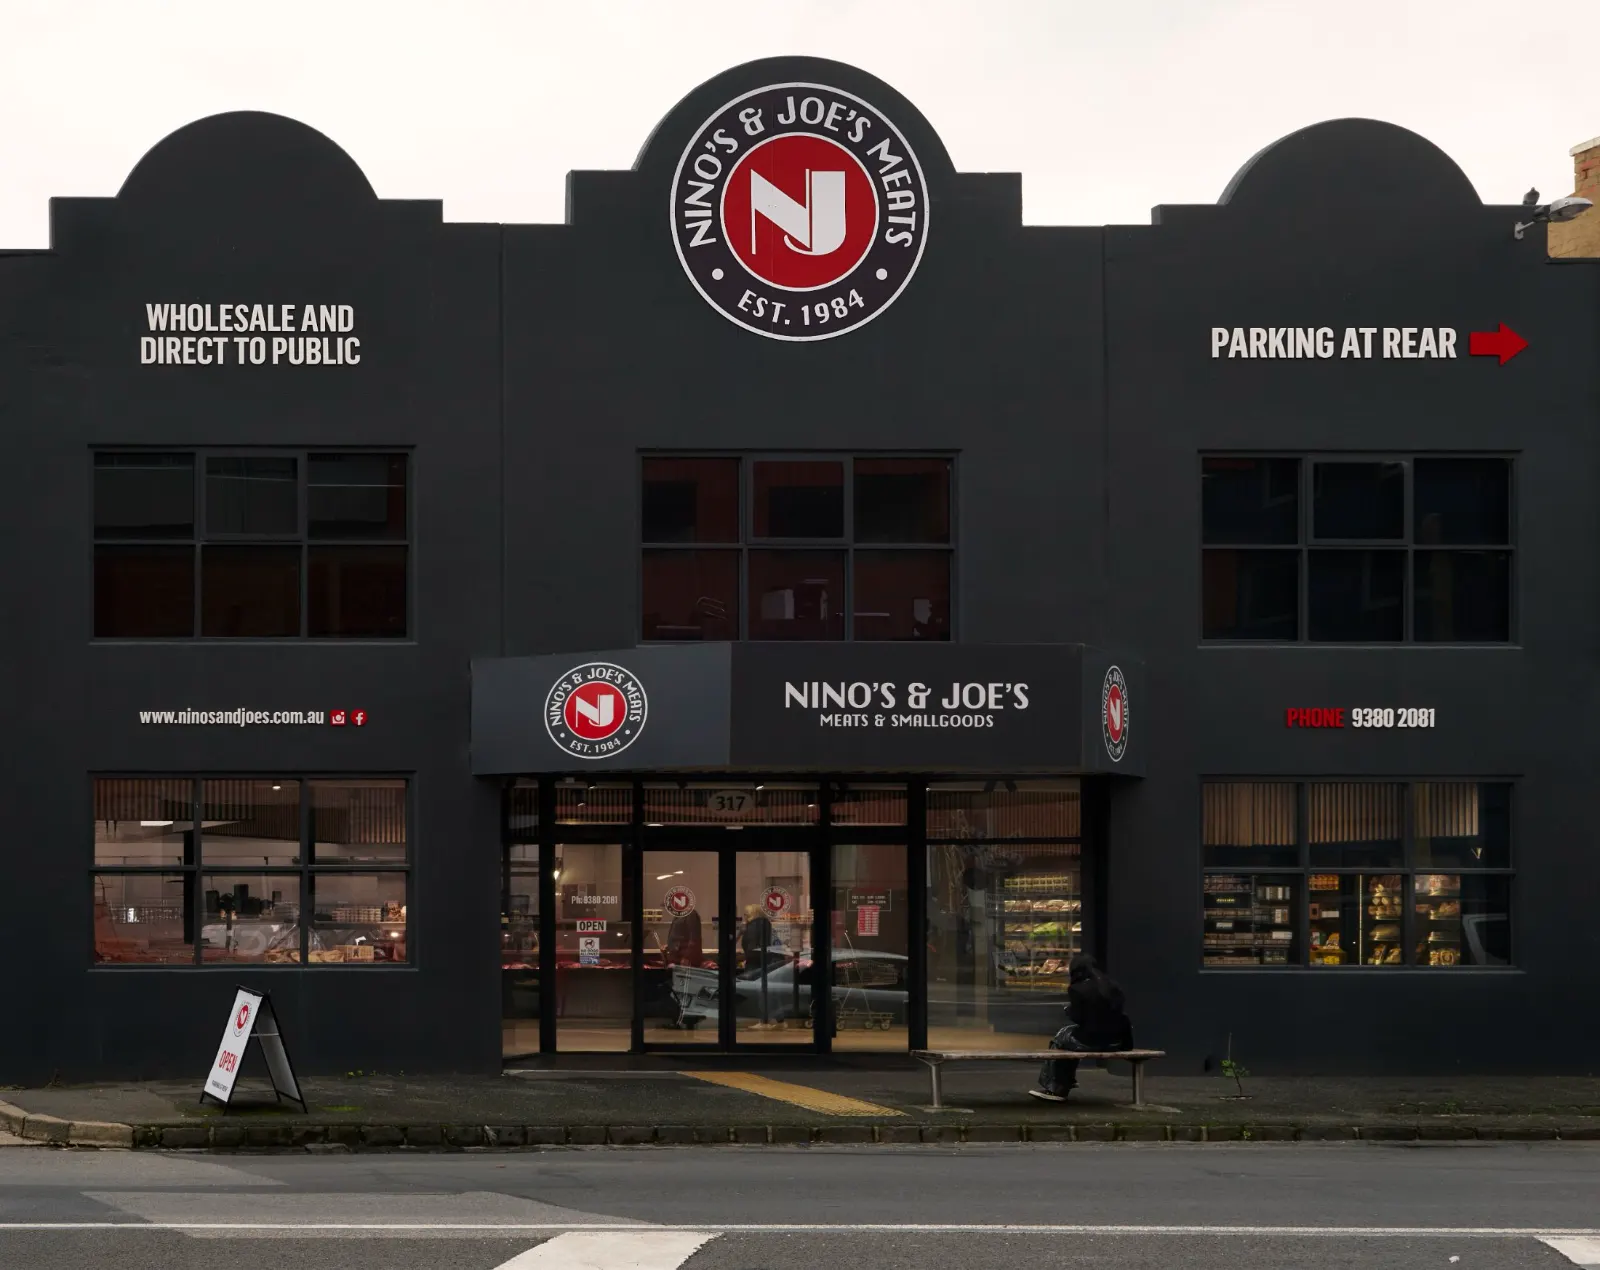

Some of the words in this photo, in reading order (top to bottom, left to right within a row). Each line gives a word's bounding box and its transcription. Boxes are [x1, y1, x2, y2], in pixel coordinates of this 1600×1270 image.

[684, 128, 738, 248] NINO'S
[738, 107, 765, 136] &
[777, 96, 871, 143] JOE'S
[866, 137, 916, 248] MEATS
[146, 303, 295, 332] WHOLESALE
[301, 304, 354, 332] AND
[737, 289, 791, 325] EST.
[801, 288, 865, 326] 1984
[140, 336, 229, 365] DIRECT
[233, 336, 266, 365] TO
[272, 336, 361, 365] PUBLIC
[1211, 326, 1334, 359] PARKING
[1340, 327, 1377, 359] AT
[1382, 327, 1457, 360] REAR
[549, 681, 572, 727] NINO'S
[571, 672, 583, 684] &
[587, 667, 625, 685] JOE'S
[622, 680, 643, 722] MEATS
[785, 682, 896, 709] NINO'S
[907, 682, 932, 709] &
[941, 682, 1029, 710] JOE'S
[139, 707, 325, 728] www.ninosandjoes.com.au
[820, 713, 868, 727] MEATS
[874, 713, 886, 727] &
[891, 714, 994, 728] SMALLGOODS
[1285, 707, 1345, 728] PHONE
[1351, 707, 1394, 728] 9380
[1397, 707, 1436, 728] 2081
[569, 739, 592, 753] EST.
[594, 738, 621, 753] 1984
[715, 795, 746, 812] 317
[601, 895, 618, 905] 2081
[579, 921, 605, 931] OPEN
[218, 1049, 238, 1073] OPEN
